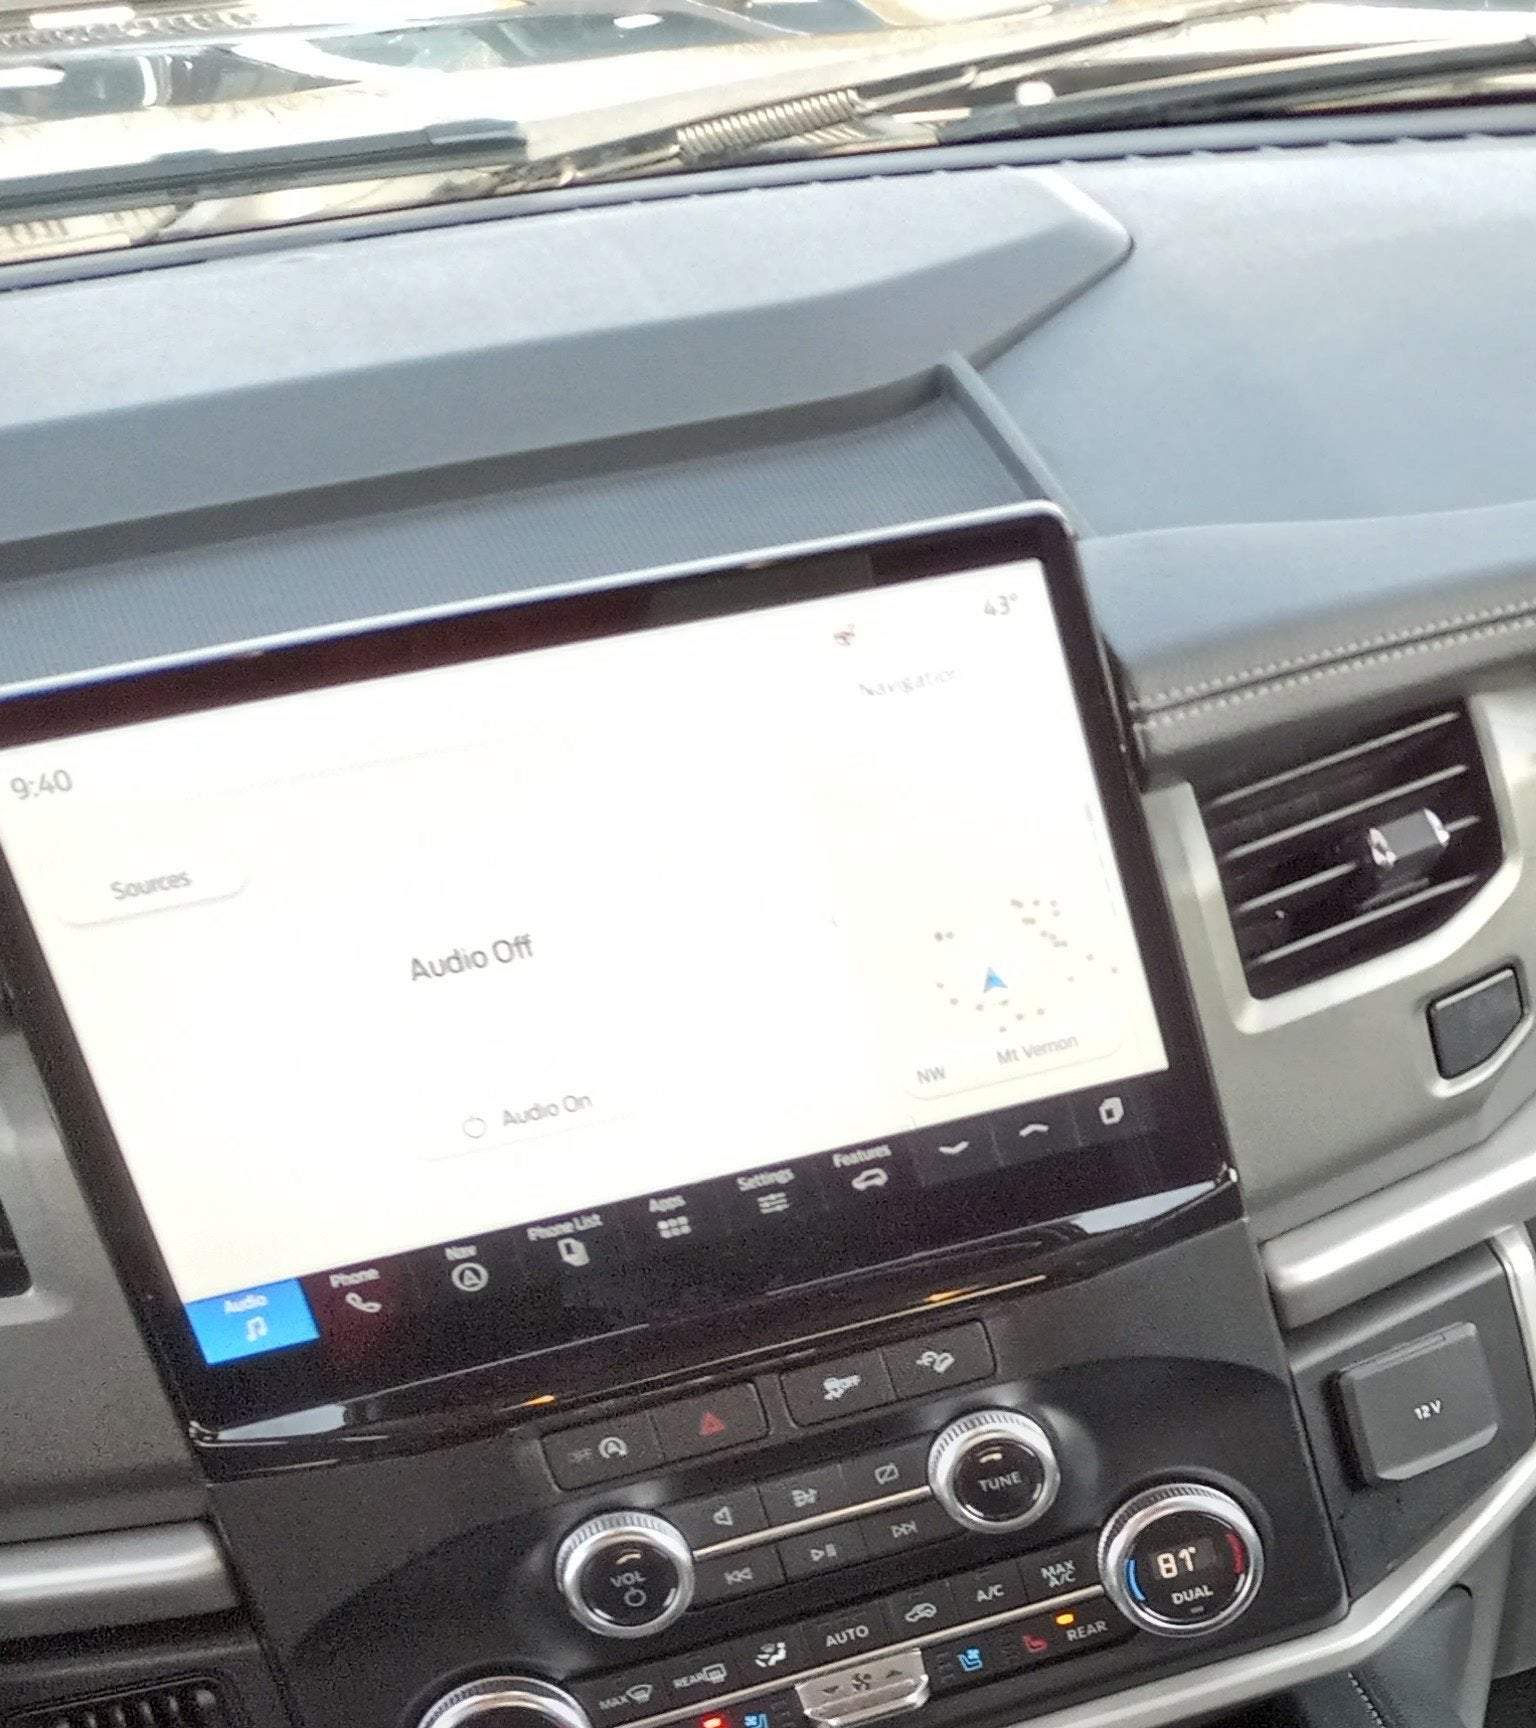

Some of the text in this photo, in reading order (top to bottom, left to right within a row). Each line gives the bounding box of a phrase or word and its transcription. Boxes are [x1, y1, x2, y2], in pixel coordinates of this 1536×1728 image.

[9, 769, 73, 801] 9:40
[110, 870, 192, 901] Sources
[409, 934, 534, 982] Audio Off
[995, 1034, 1079, 1066] Mt Vernon
[916, 1065, 947, 1086] NW
[502, 1094, 593, 1128] Audio On
[832, 1144, 893, 1168] Features
[736, 1168, 795, 1192] Settings
[527, 1223, 575, 1243] Phone
[328, 1266, 381, 1289] Phone
[223, 1292, 268, 1316] Audio
[1414, 1400, 1443, 1420] 12V
[977, 1470, 1023, 1493] TUNE
[610, 1570, 647, 1588] VOL
[1040, 1560, 1076, 1579] MAX
[1048, 1570, 1077, 1588] A/C
[976, 1584, 1005, 1602] A/C
[1171, 1585, 1214, 1605] DUAL
[825, 1625, 870, 1648] AUTO
[1066, 1620, 1109, 1642] REAR
[673, 1672, 706, 1689] REAR
